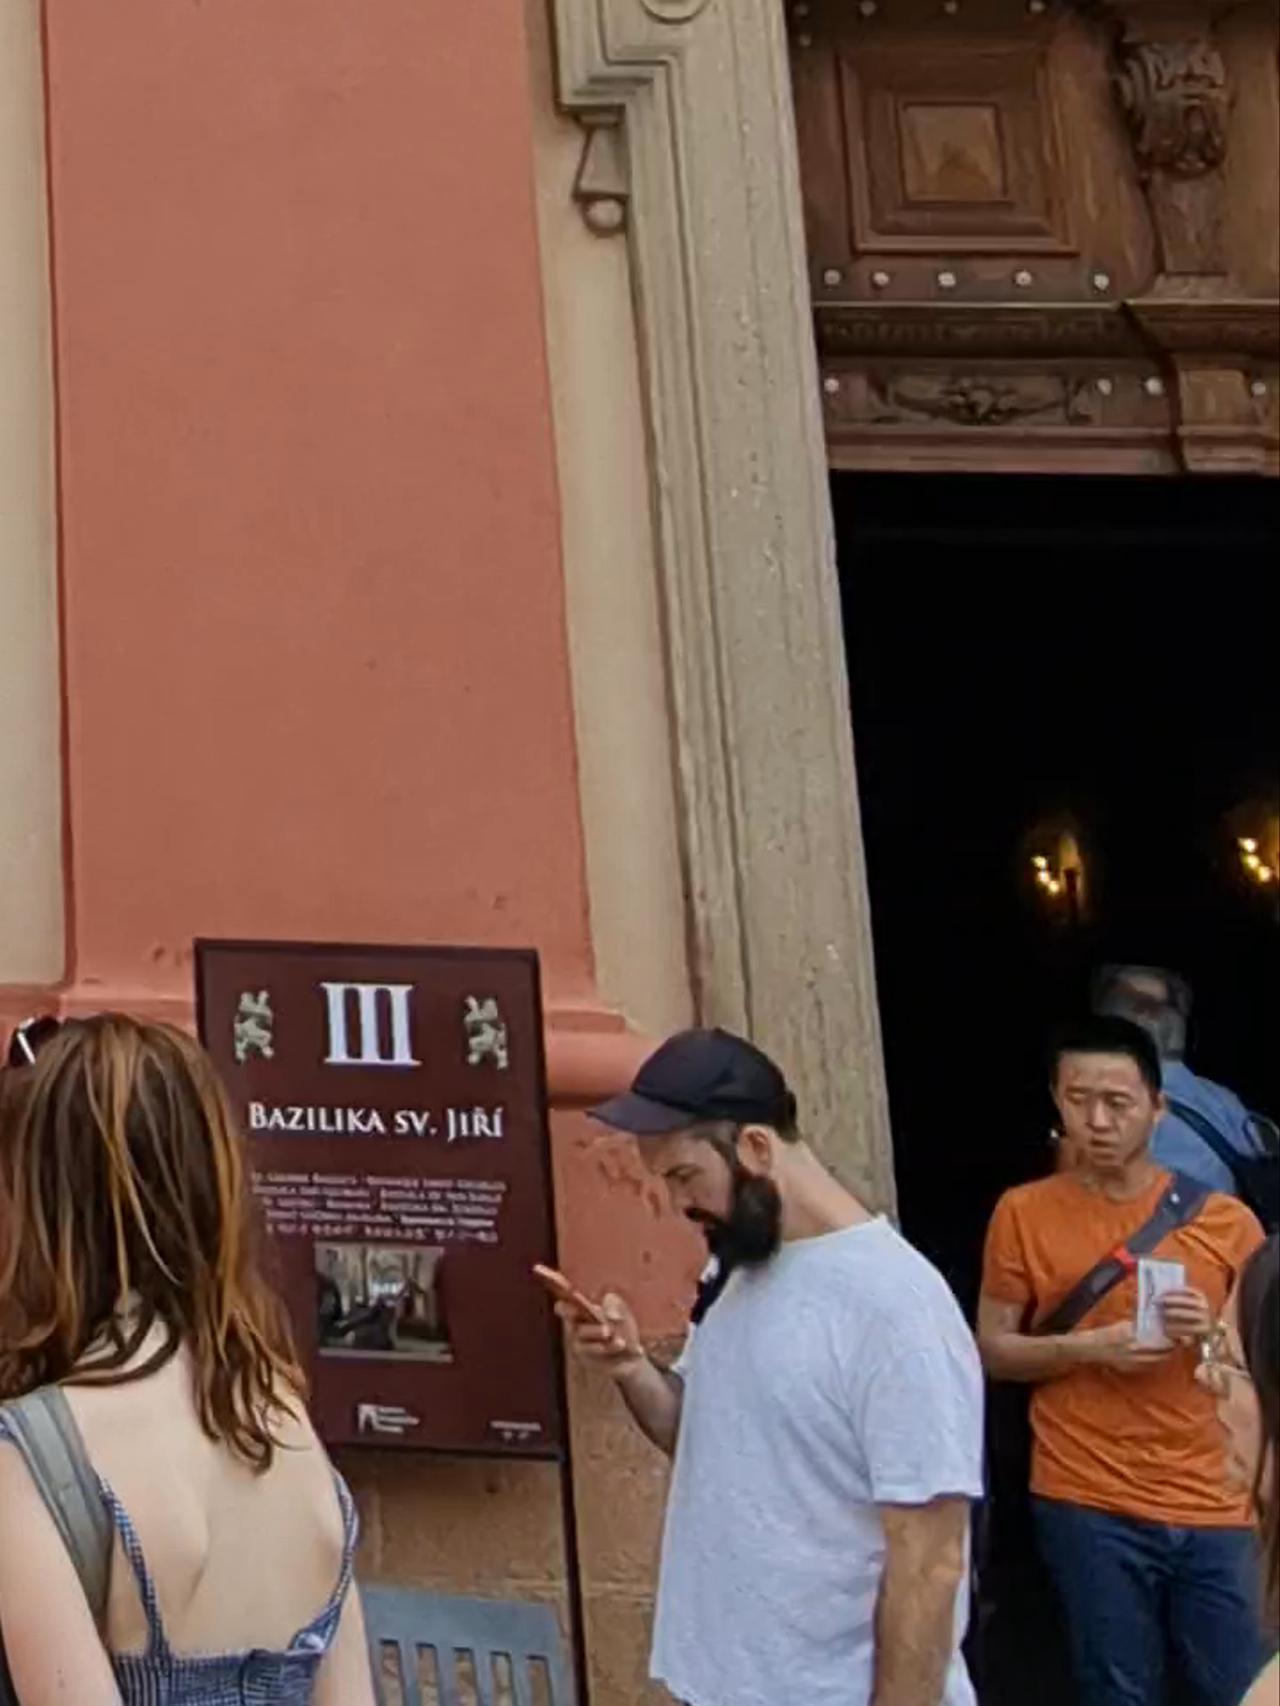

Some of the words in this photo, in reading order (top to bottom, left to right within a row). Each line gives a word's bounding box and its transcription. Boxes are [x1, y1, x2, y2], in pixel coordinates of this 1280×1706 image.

[320, 982, 423, 1067] III
[247, 1102, 387, 1135] BAZILIKA
[393, 1109, 439, 1136] SV.
[447, 1105, 505, 1142] JIŘÍ
